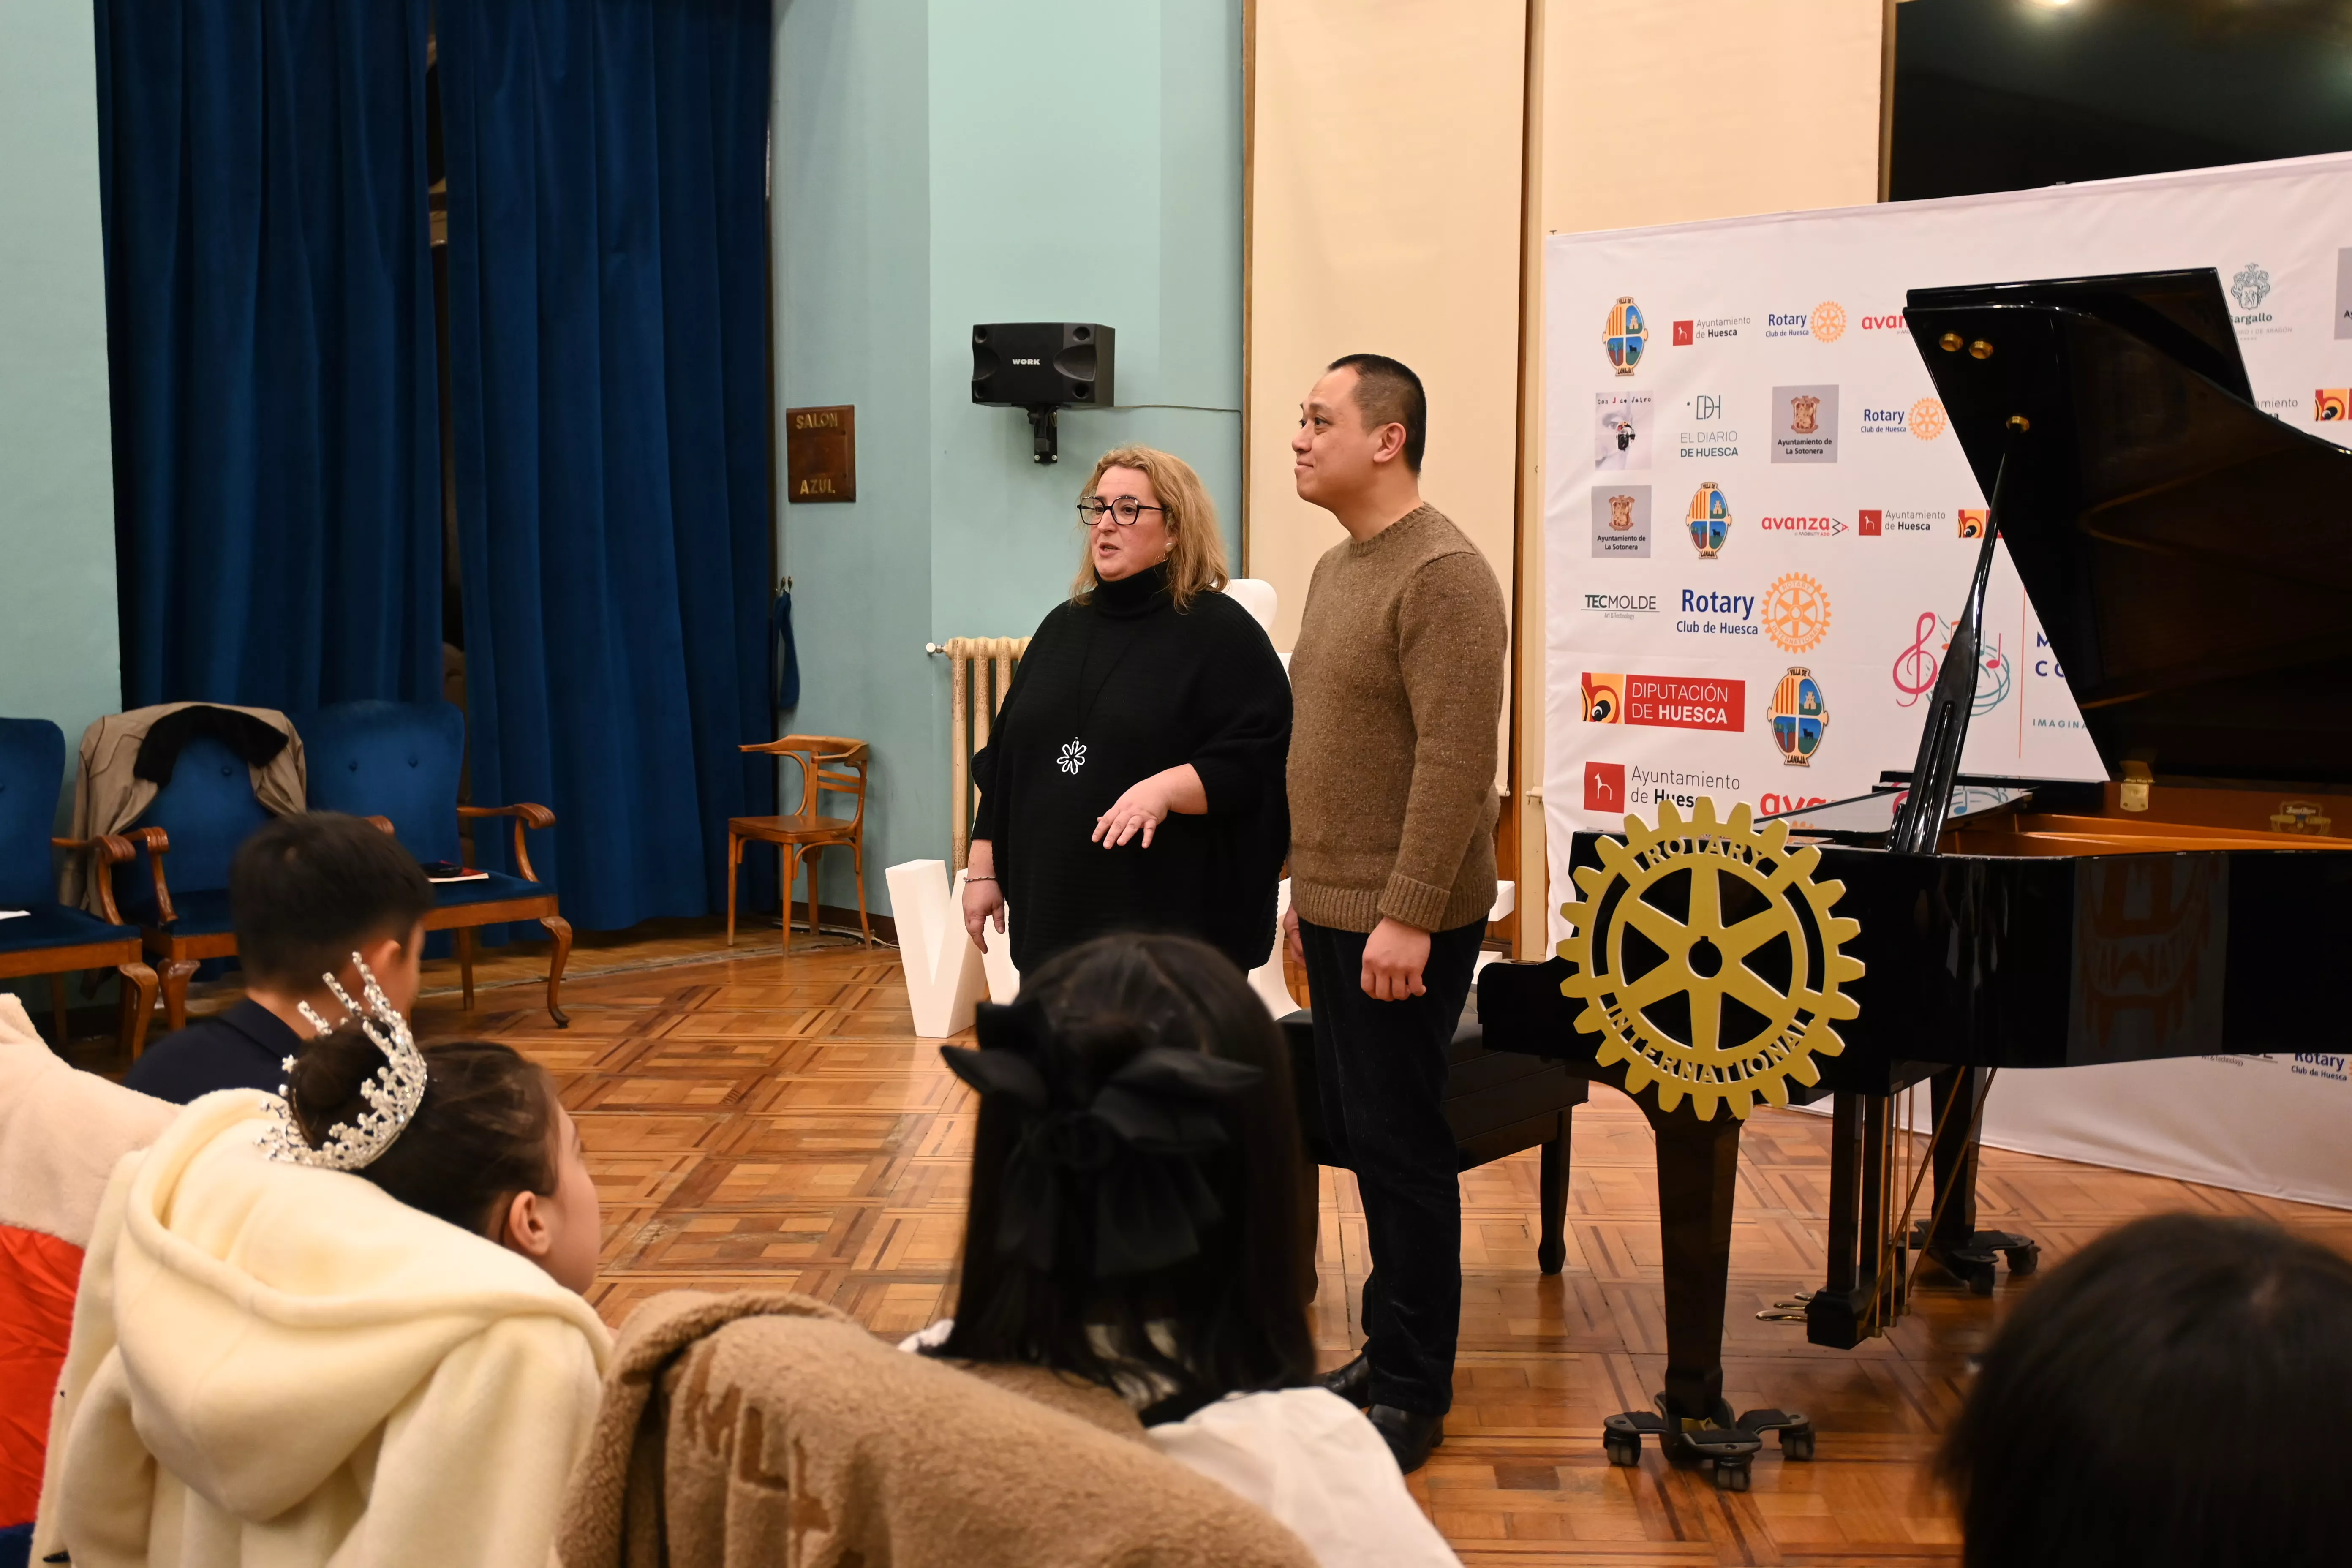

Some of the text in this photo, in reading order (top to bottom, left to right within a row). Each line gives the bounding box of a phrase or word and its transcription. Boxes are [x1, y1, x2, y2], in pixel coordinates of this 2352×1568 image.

[1696, 316, 1750, 328] Ayuntamiento
[1769, 314, 1807, 327] Rotary
[1696, 329, 1737, 338] de Huesca
[796, 412, 838, 429] SALON
[1864, 408, 1904, 425] Rotary
[1681, 430, 1737, 443] EL DIARIO
[1778, 438, 1822, 447] Ayuntamiento
[1681, 447, 1738, 457] DE HUESCA
[800, 479, 836, 495] AZUL
[1885, 510, 1945, 521] Ayuntamiento
[1761, 517, 1830, 530] avanza
[1885, 522, 1930, 531] de Huesca
[1782, 581, 1811, 591] ROTARY
[1585, 594, 1656, 610] TECMOLDE
[1682, 589, 1755, 621] Rotary
[1677, 621, 1758, 634] Club de Huesca
[1632, 683, 1728, 702] DIPUTACIÓN
[1632, 703, 1727, 724] DE HUESCA
[1787, 754, 1806, 765] LANAJA
[1632, 766, 1740, 790] Ayuntamiento
[1631, 787, 1648, 803] de
[1646, 835, 1764, 868] ROTARY
[1606, 1006, 1813, 1084] INTERNATIONAL
[2291, 1065, 2347, 1081] Club de Huesca
